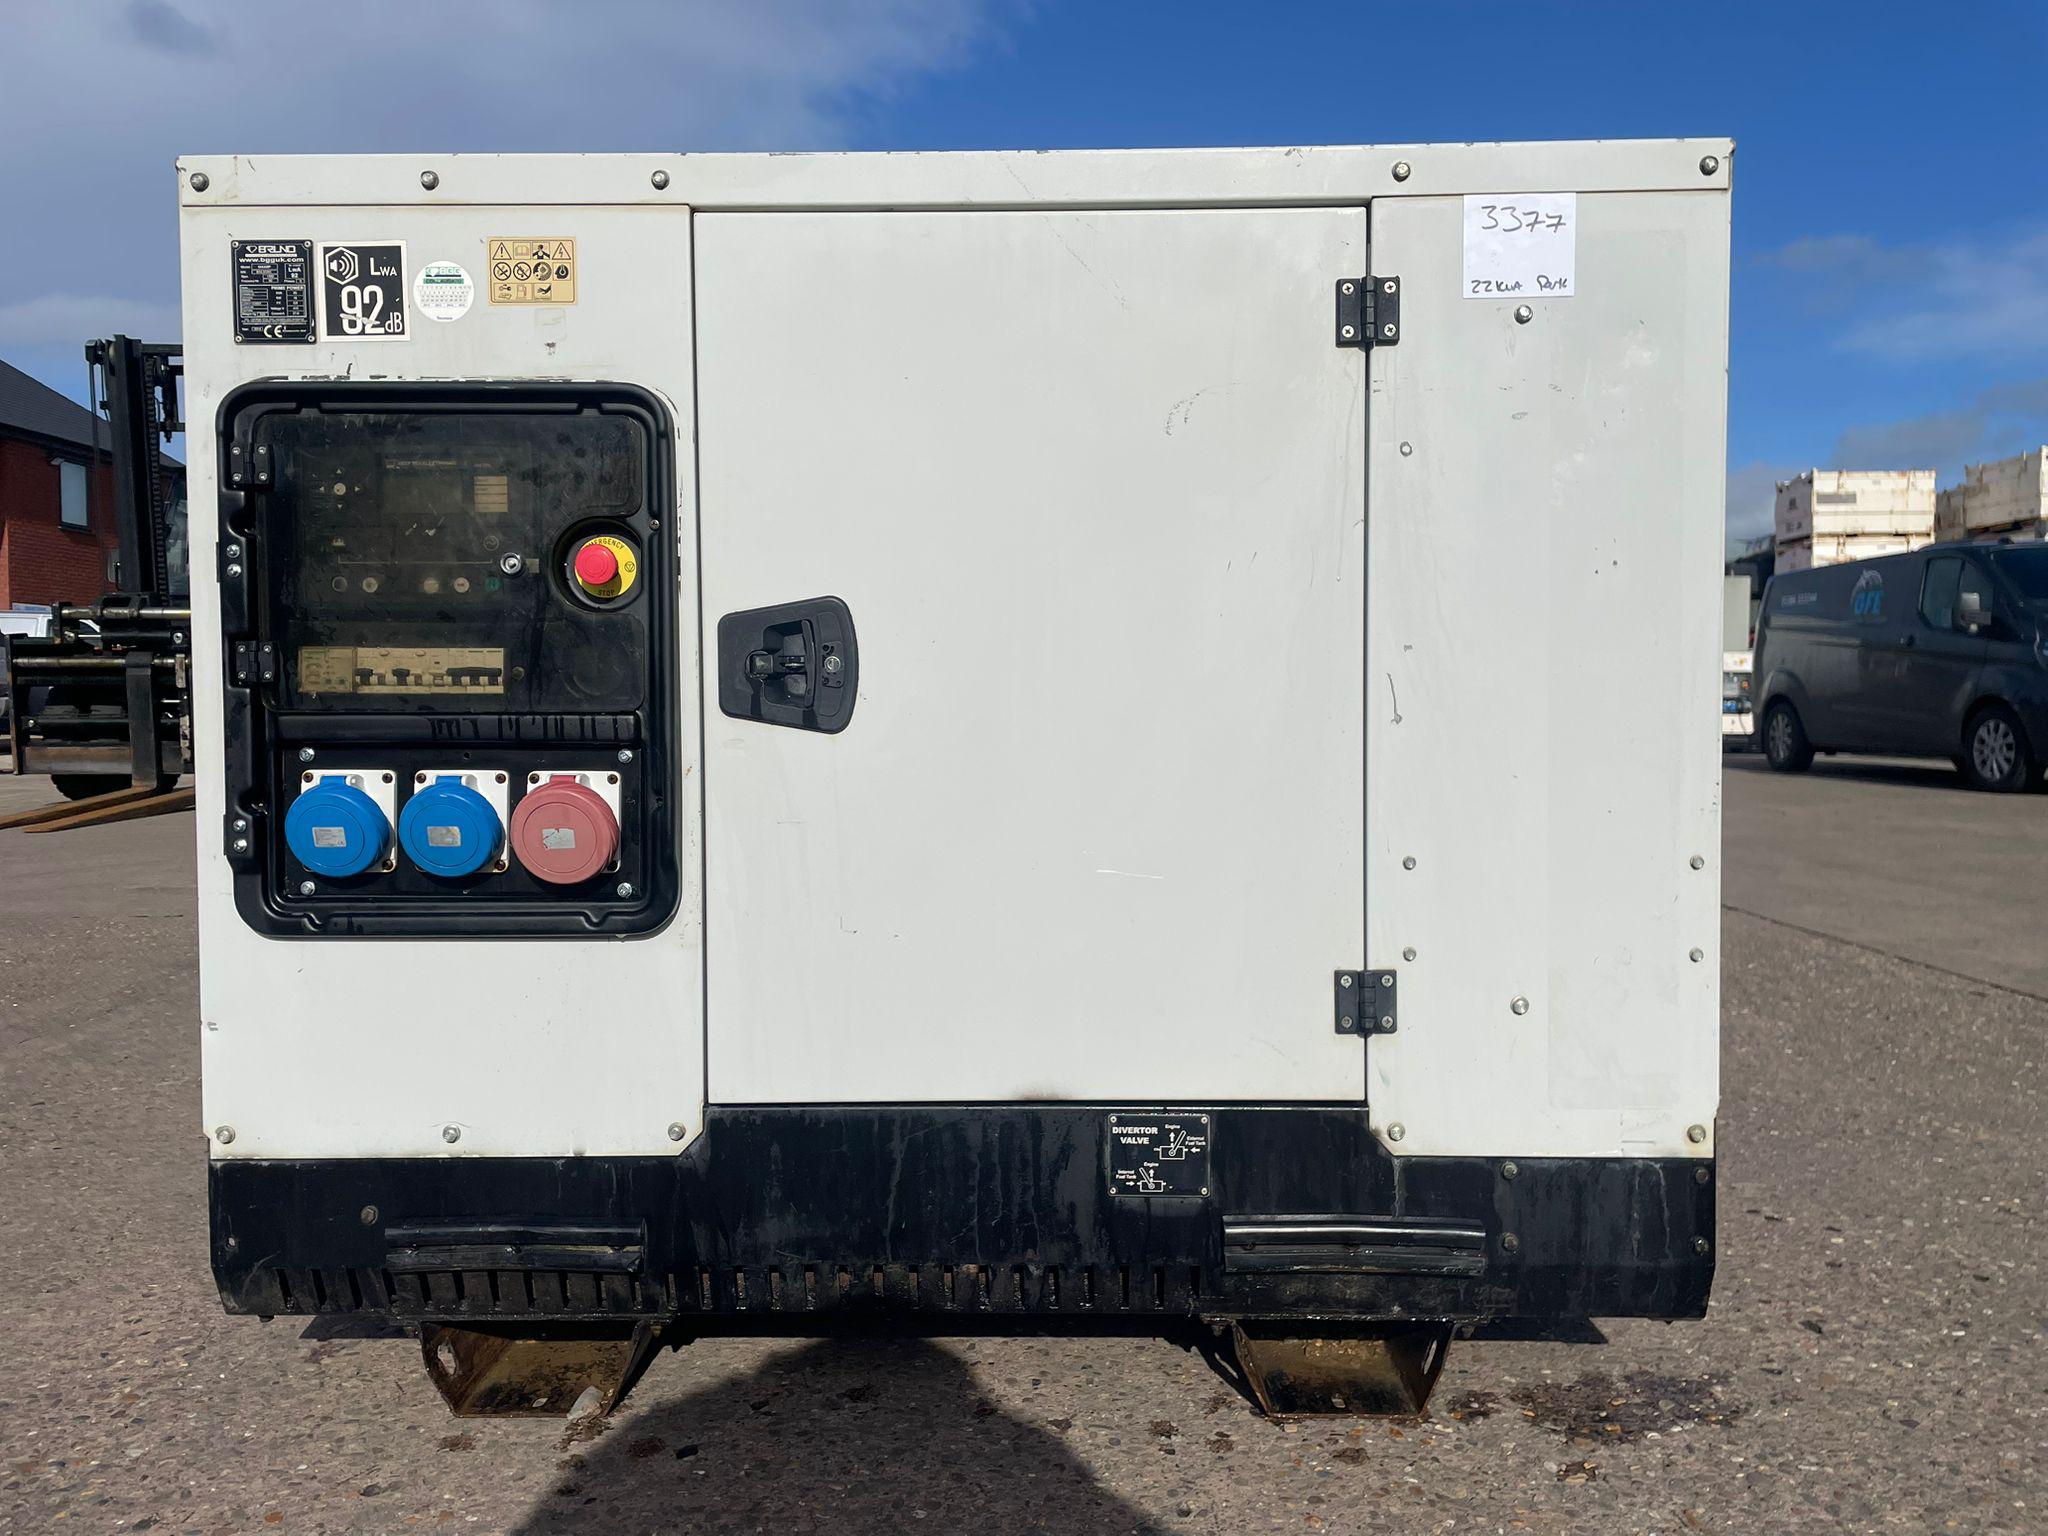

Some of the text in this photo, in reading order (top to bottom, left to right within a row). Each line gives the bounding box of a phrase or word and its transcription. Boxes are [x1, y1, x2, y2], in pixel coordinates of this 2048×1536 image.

[1481, 205, 1566, 233] 3377
[258, 245, 296, 253] BRUNO
[340, 285, 384, 334] 92
[385, 312, 403, 333] dB
[588, 538, 625, 550] ERGENCY
[599, 588, 614, 596] STOP
